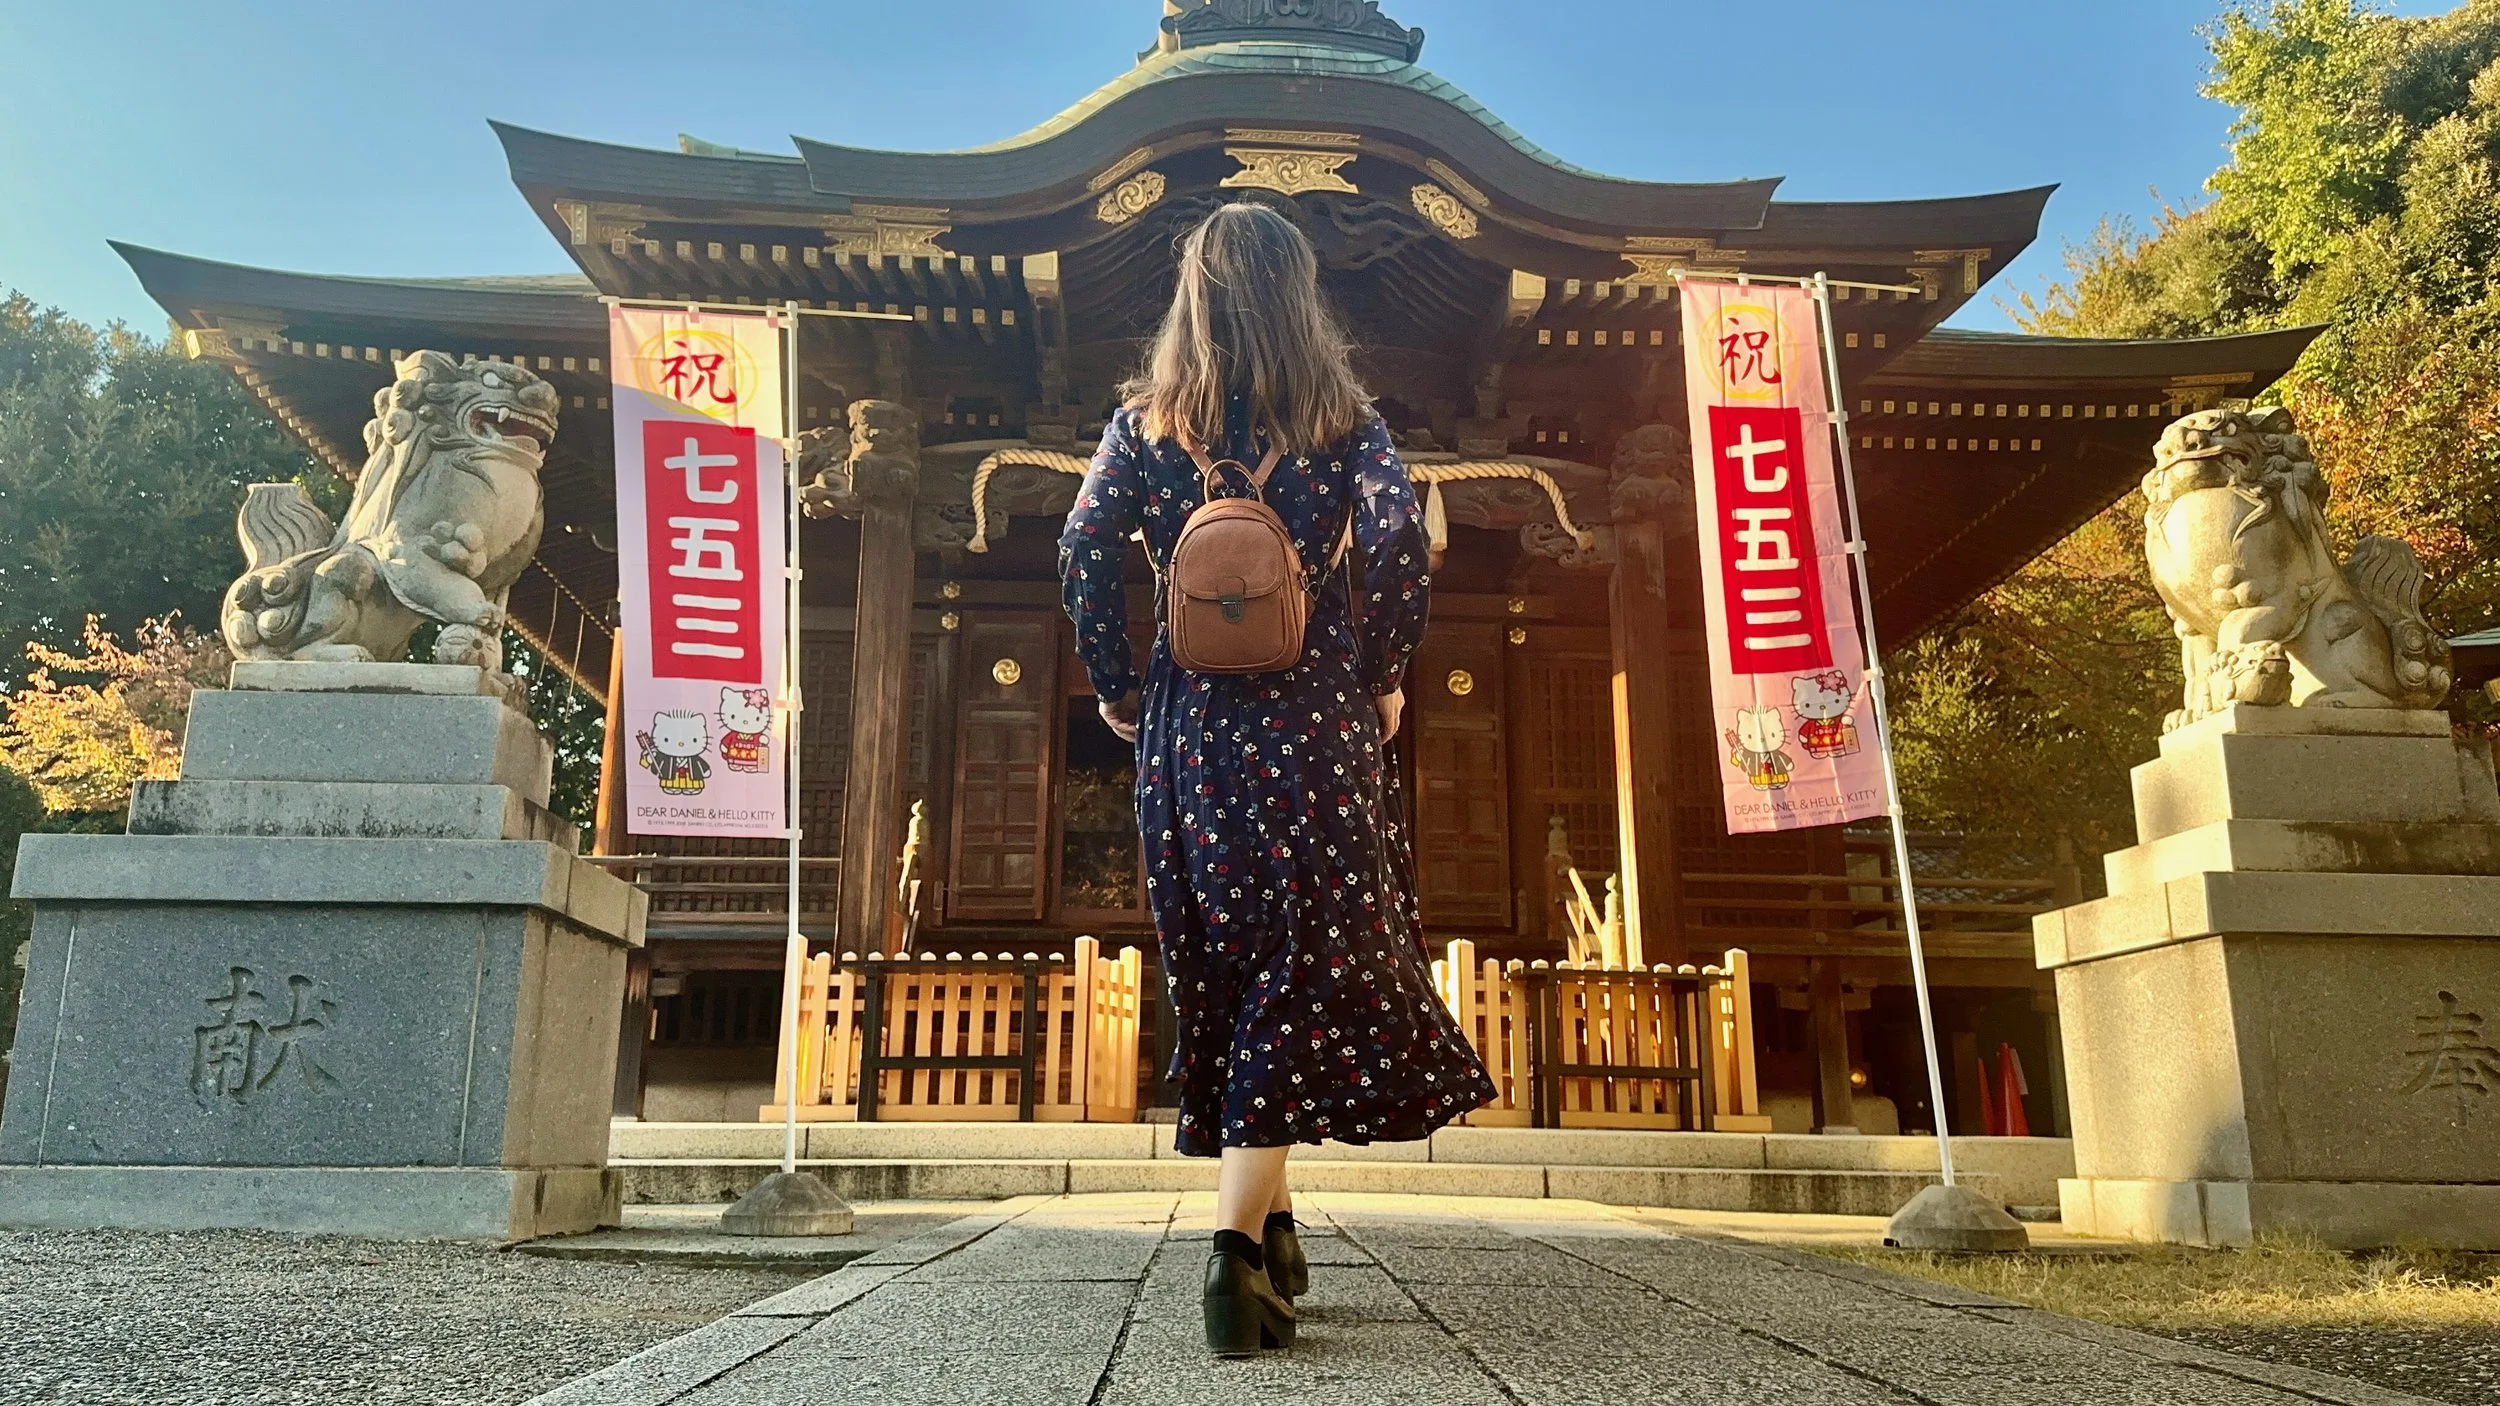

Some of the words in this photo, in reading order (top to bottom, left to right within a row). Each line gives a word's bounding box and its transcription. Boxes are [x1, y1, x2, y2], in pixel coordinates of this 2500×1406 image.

[659, 340, 737, 404] 祝
[1718, 317, 1782, 386] 祝
[663, 436, 745, 660] 七五三
[1725, 423, 1812, 651] 七五三
[637, 806, 667, 817] DEAR
[670, 807, 707, 819] DANIEL
[708, 808, 717, 819] &
[718, 809, 748, 820] HELLO
[750, 810, 776, 821] KITTY
[1734, 804, 1761, 816] DEAR
[1763, 801, 1798, 814] DANIEL
[1800, 799, 1809, 809] &
[1810, 795, 1845, 808] HELLO
[1846, 789, 1878, 803] KITTY
[189, 965, 344, 1106] 献
[2399, 990, 2500, 1127] 奉
